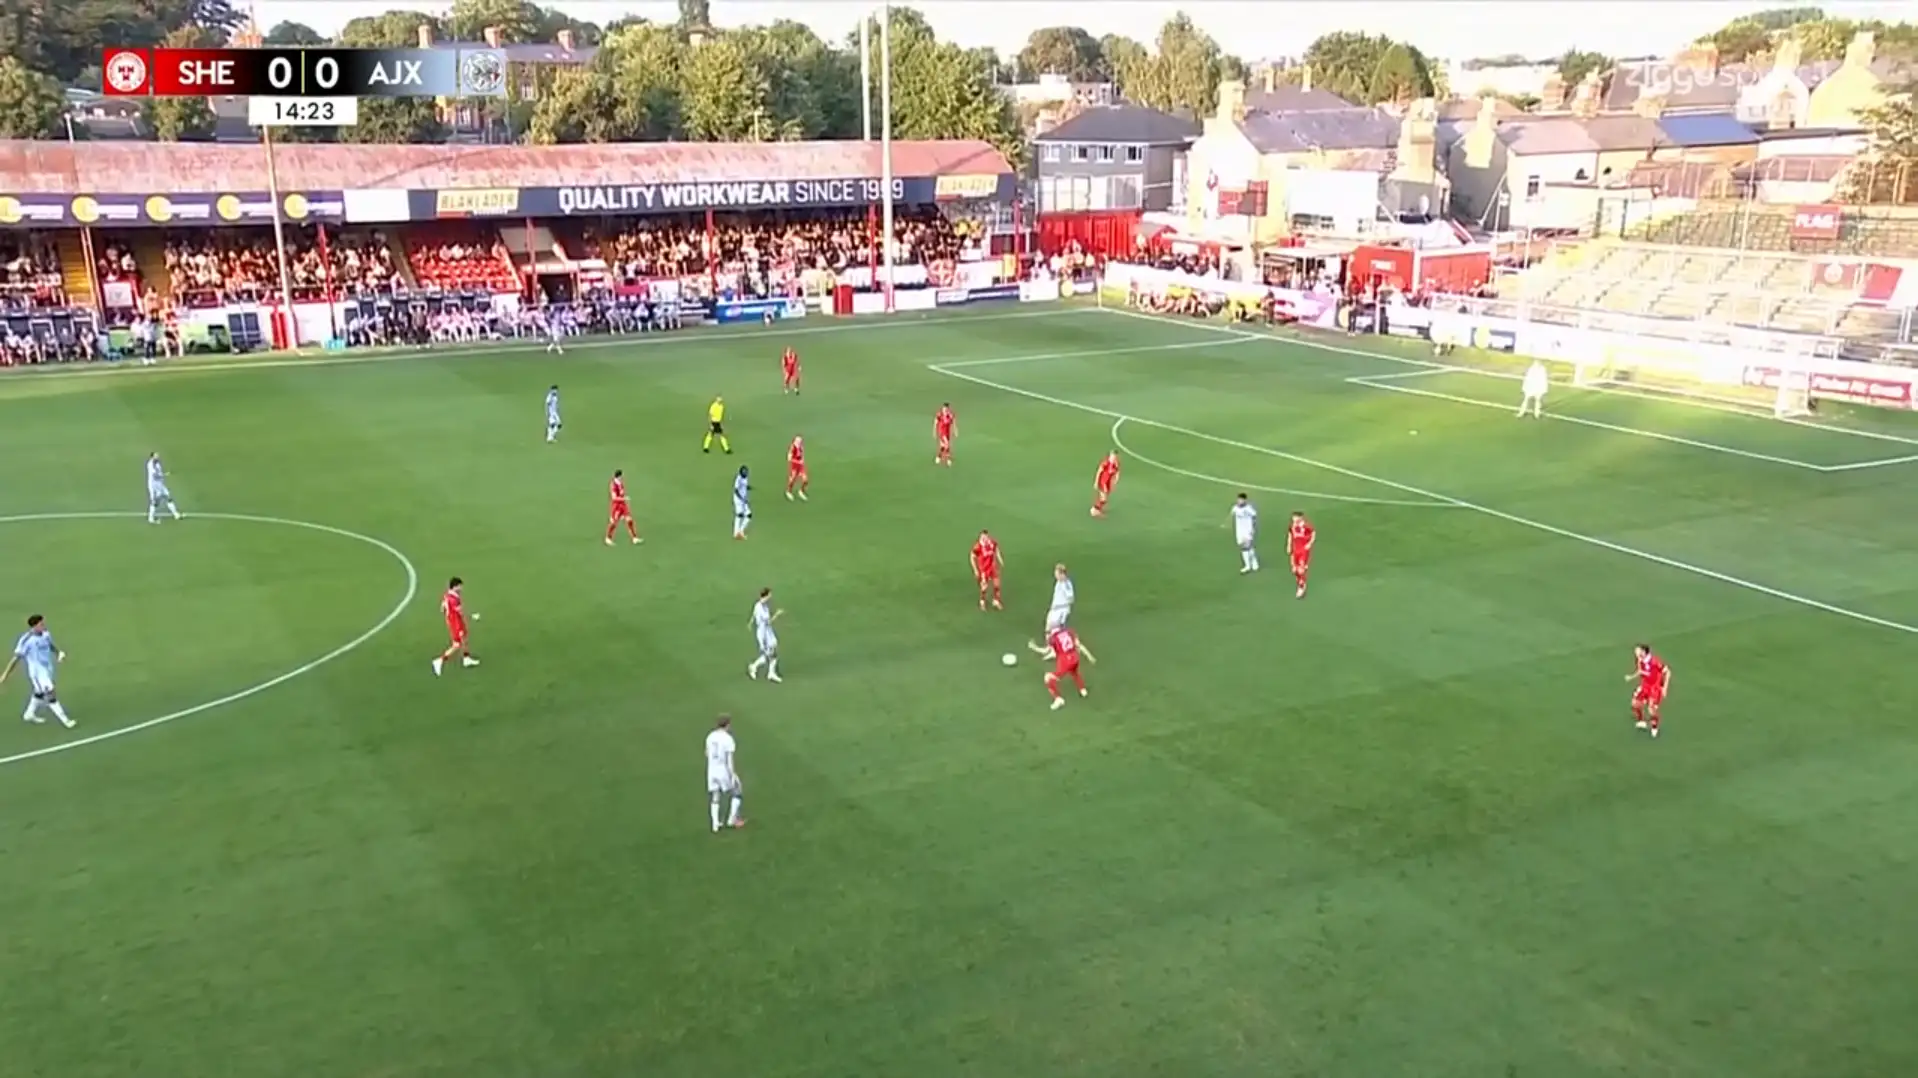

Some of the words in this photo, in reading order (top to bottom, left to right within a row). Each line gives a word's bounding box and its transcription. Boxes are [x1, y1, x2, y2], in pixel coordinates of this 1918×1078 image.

[559, 186, 657, 214] QUALITY
[661, 182, 790, 206] WORKWEAR
[795, 178, 854, 203] SINCE
[859, 177, 904, 202] 199
